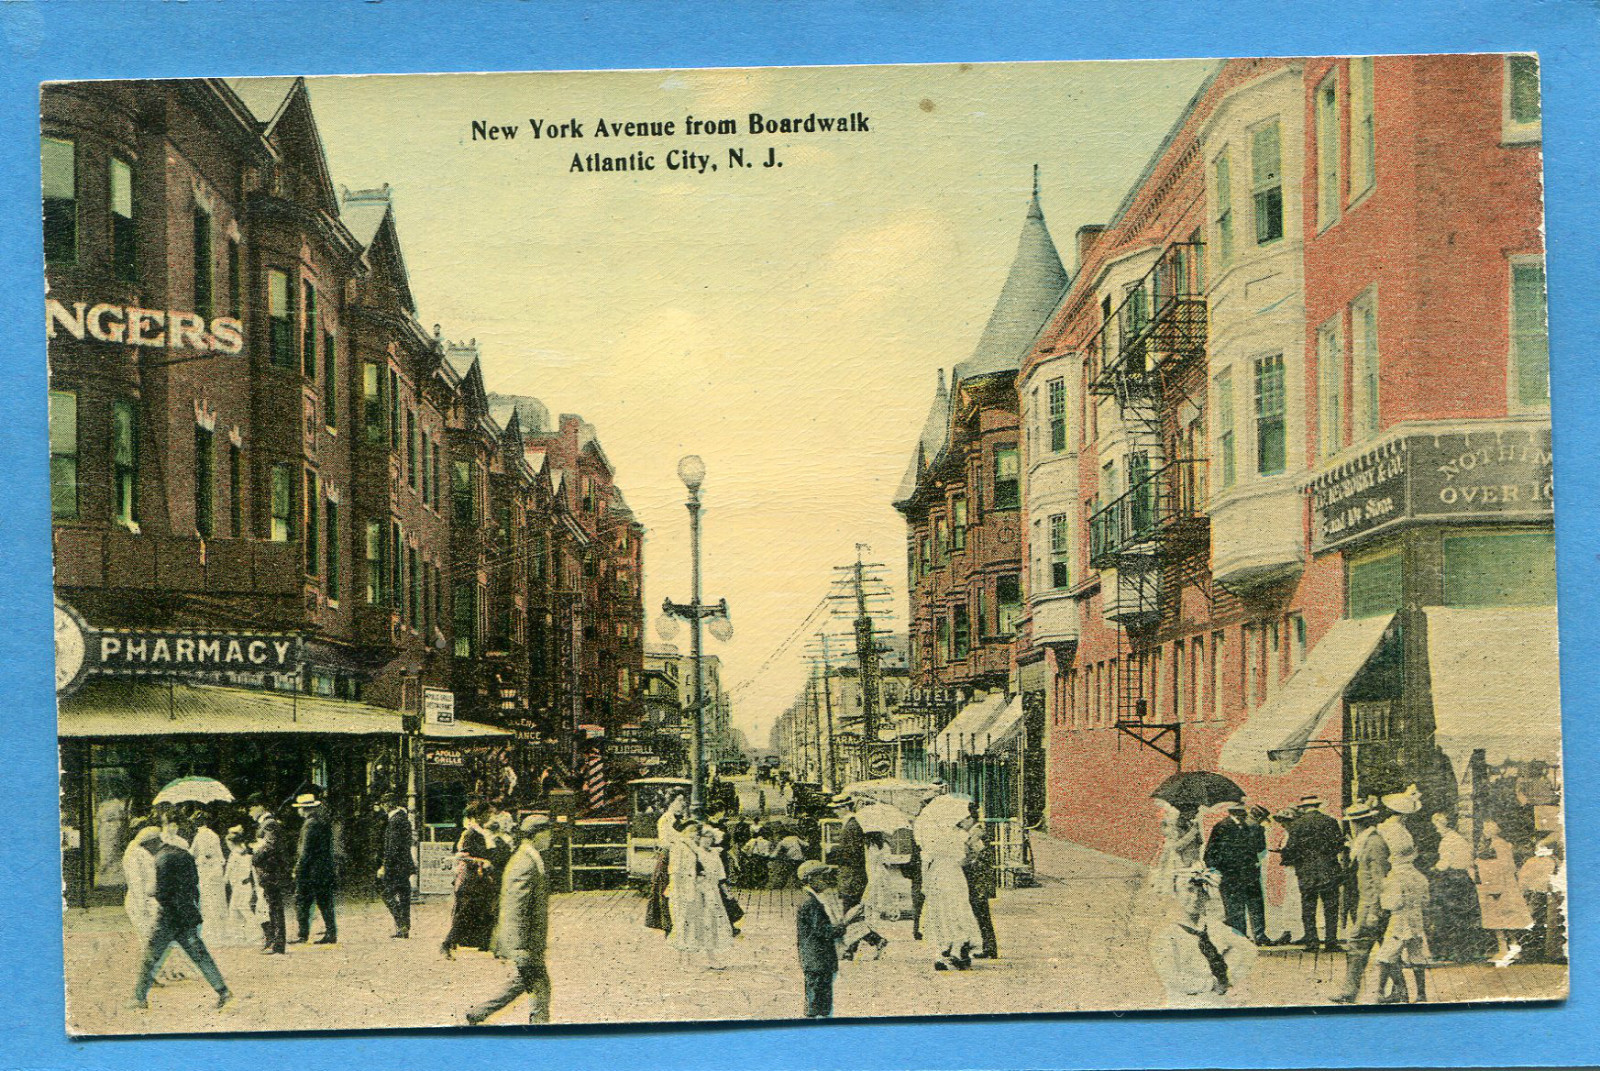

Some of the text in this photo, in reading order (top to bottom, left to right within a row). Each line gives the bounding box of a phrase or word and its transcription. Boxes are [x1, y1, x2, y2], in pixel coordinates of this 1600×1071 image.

[45, 298, 244, 355] NGERS
[1439, 484, 1520, 505] OVER
[100, 636, 290, 665] PHARMACY
[902, 686, 953, 703] HOTEL
